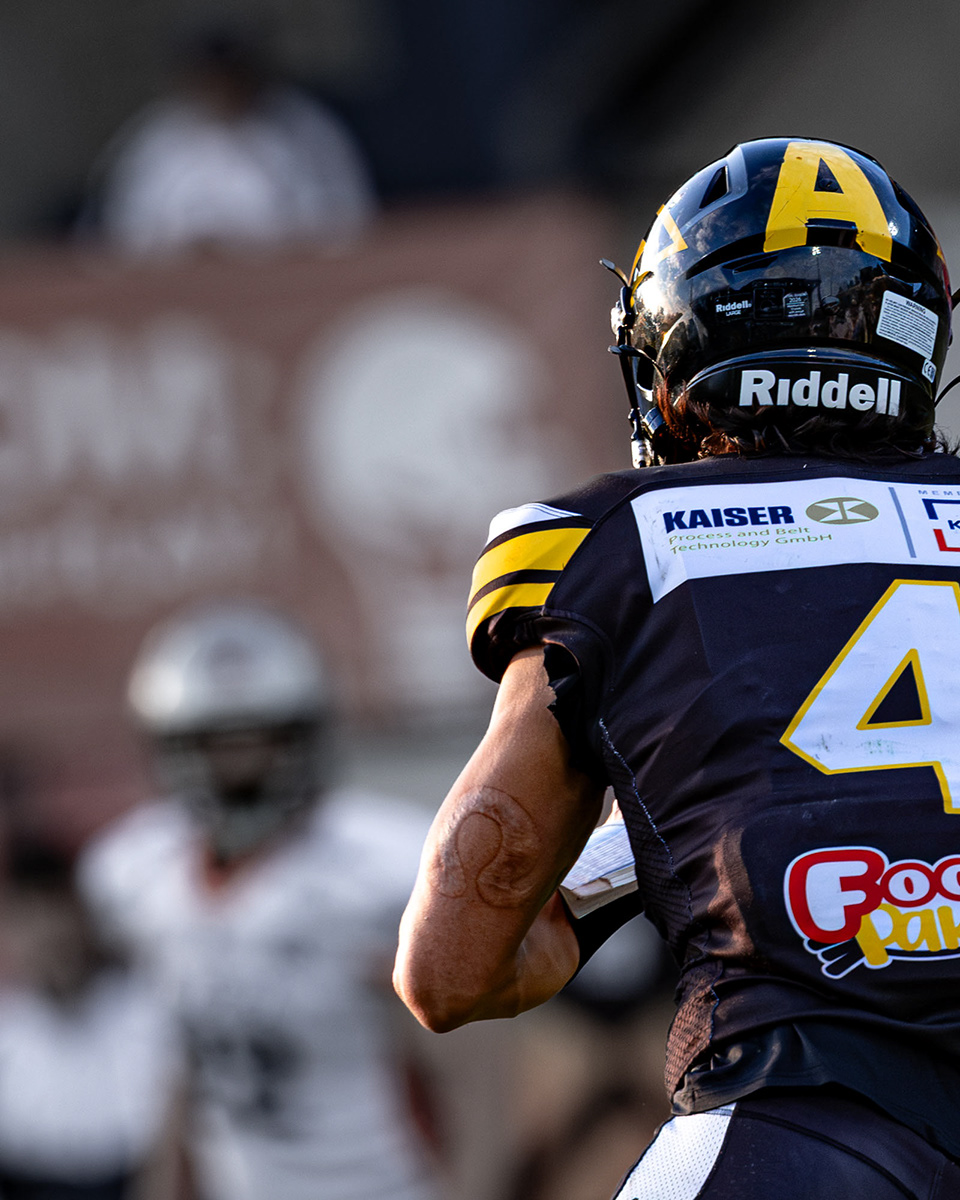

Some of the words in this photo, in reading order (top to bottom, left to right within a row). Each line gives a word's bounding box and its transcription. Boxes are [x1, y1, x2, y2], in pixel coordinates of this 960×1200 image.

[763, 142, 892, 262] A
[738, 369, 902, 417] Riddell
[662, 505, 795, 534] KAISER
[668, 530, 732, 545] Process
[737, 528, 771, 539] and
[775, 526, 811, 536] Belt
[669, 538, 770, 555] Technology
[775, 533, 833, 545] GmbH
